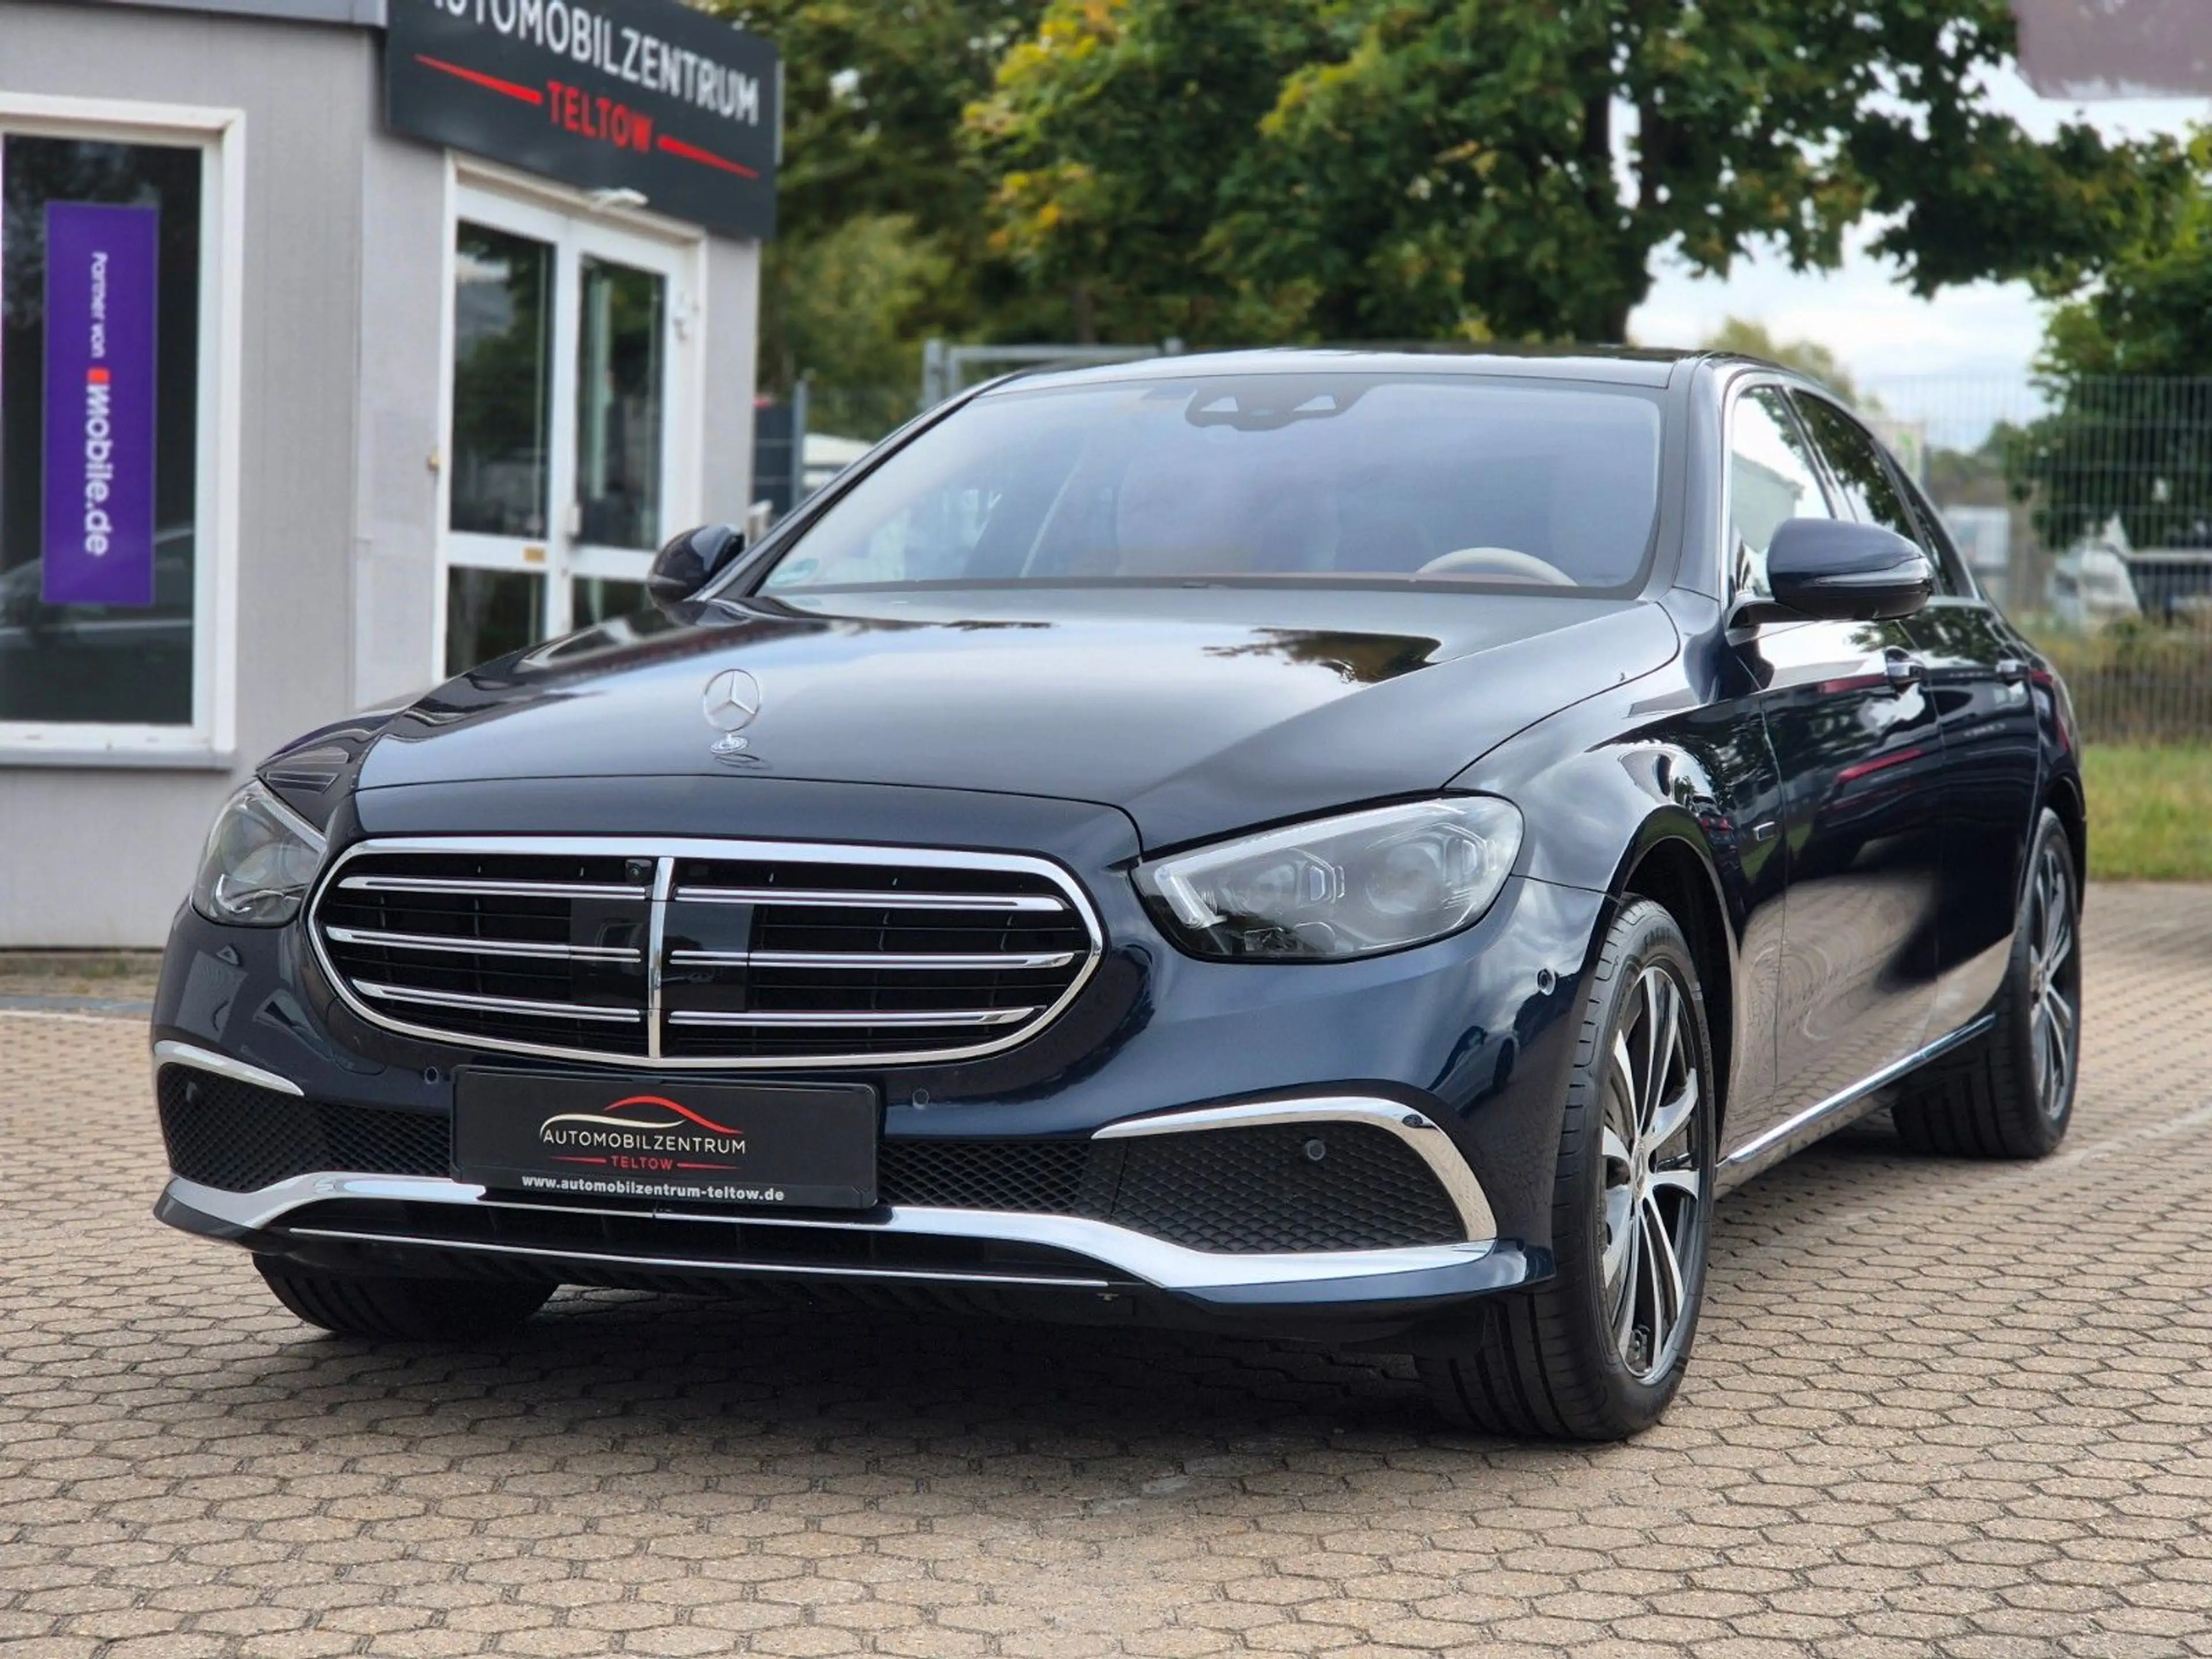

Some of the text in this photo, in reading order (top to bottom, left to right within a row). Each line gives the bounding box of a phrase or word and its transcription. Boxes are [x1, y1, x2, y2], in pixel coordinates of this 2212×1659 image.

[433, 0, 760, 125] OMOBILZENTRUM
[547, 80, 653, 153] TELTOW
[90, 322, 106, 358] von
[543, 1129, 746, 1154] AUTOMOBILZENTRUM
[610, 1155, 673, 1171] TELTOW
[521, 1176, 785, 1201] www.automobilzentrum-teltow.de
